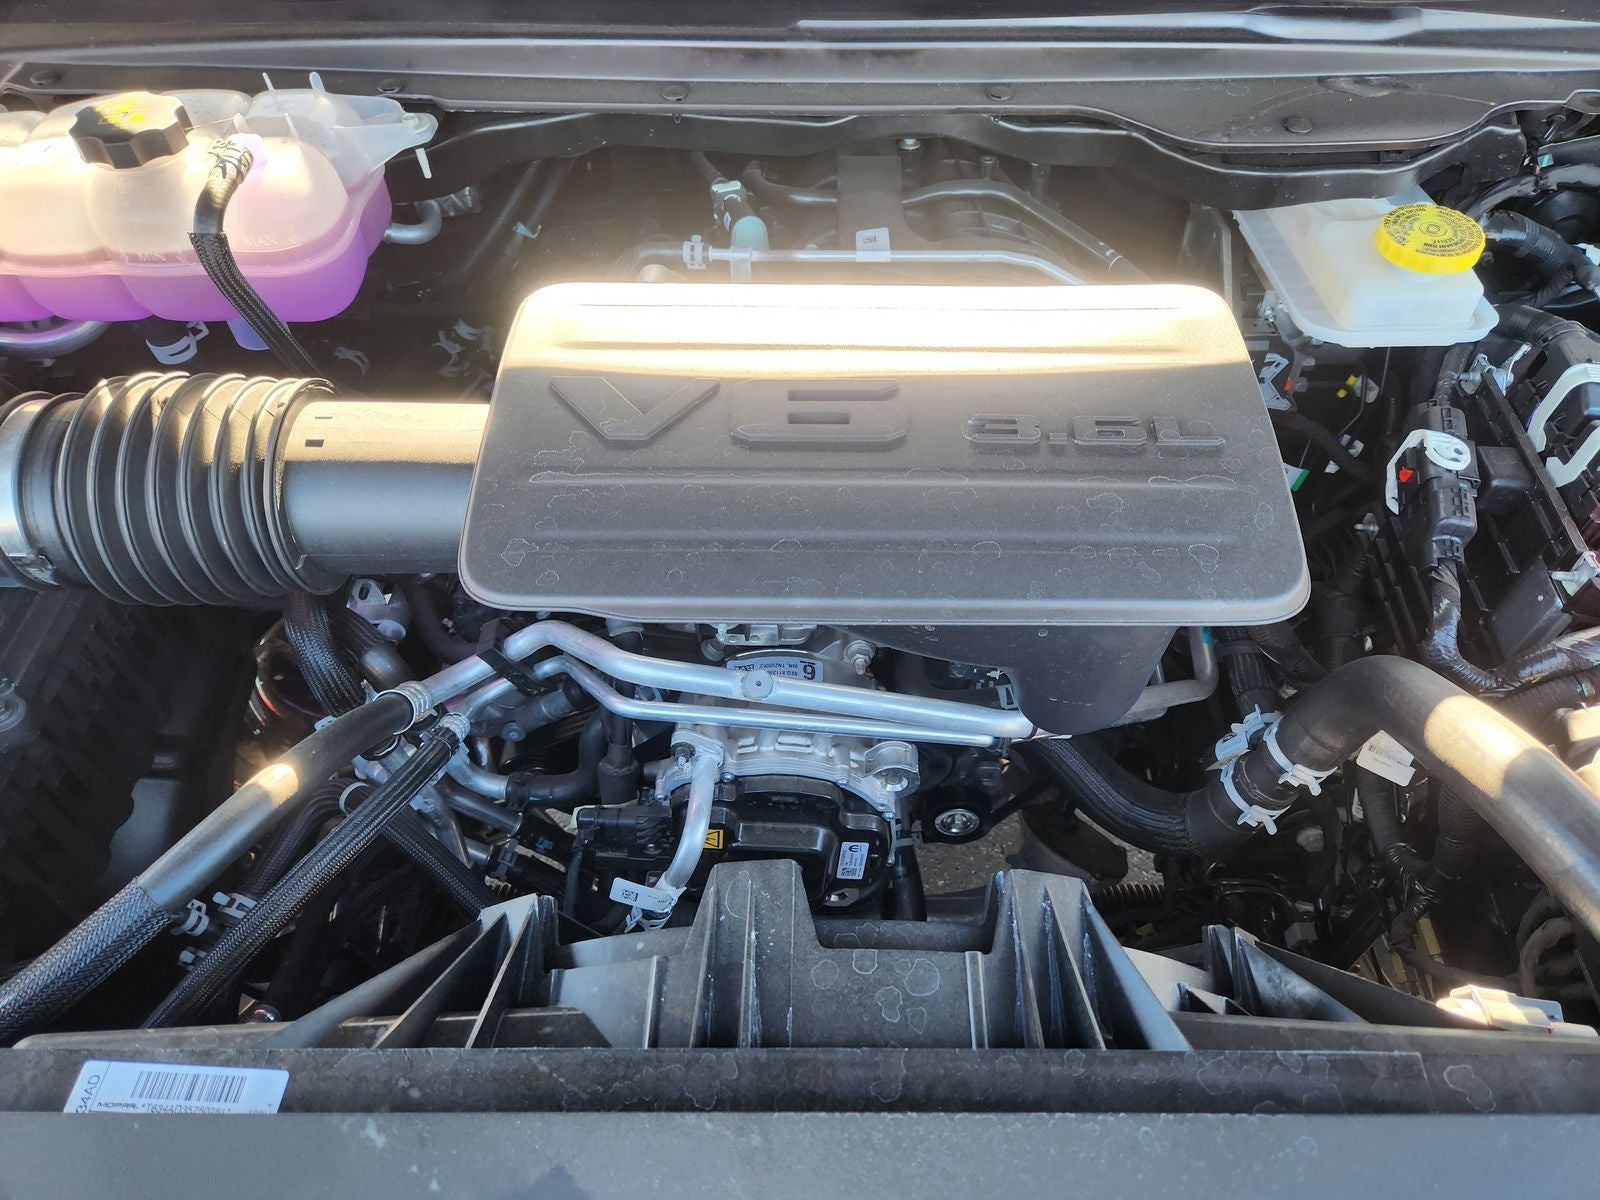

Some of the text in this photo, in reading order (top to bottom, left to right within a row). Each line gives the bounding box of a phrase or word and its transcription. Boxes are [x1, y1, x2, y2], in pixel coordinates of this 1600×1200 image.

[137, 250, 167, 262] MIN
[548, 375, 909, 445] V6
[961, 413, 1227, 449] 3.6L
